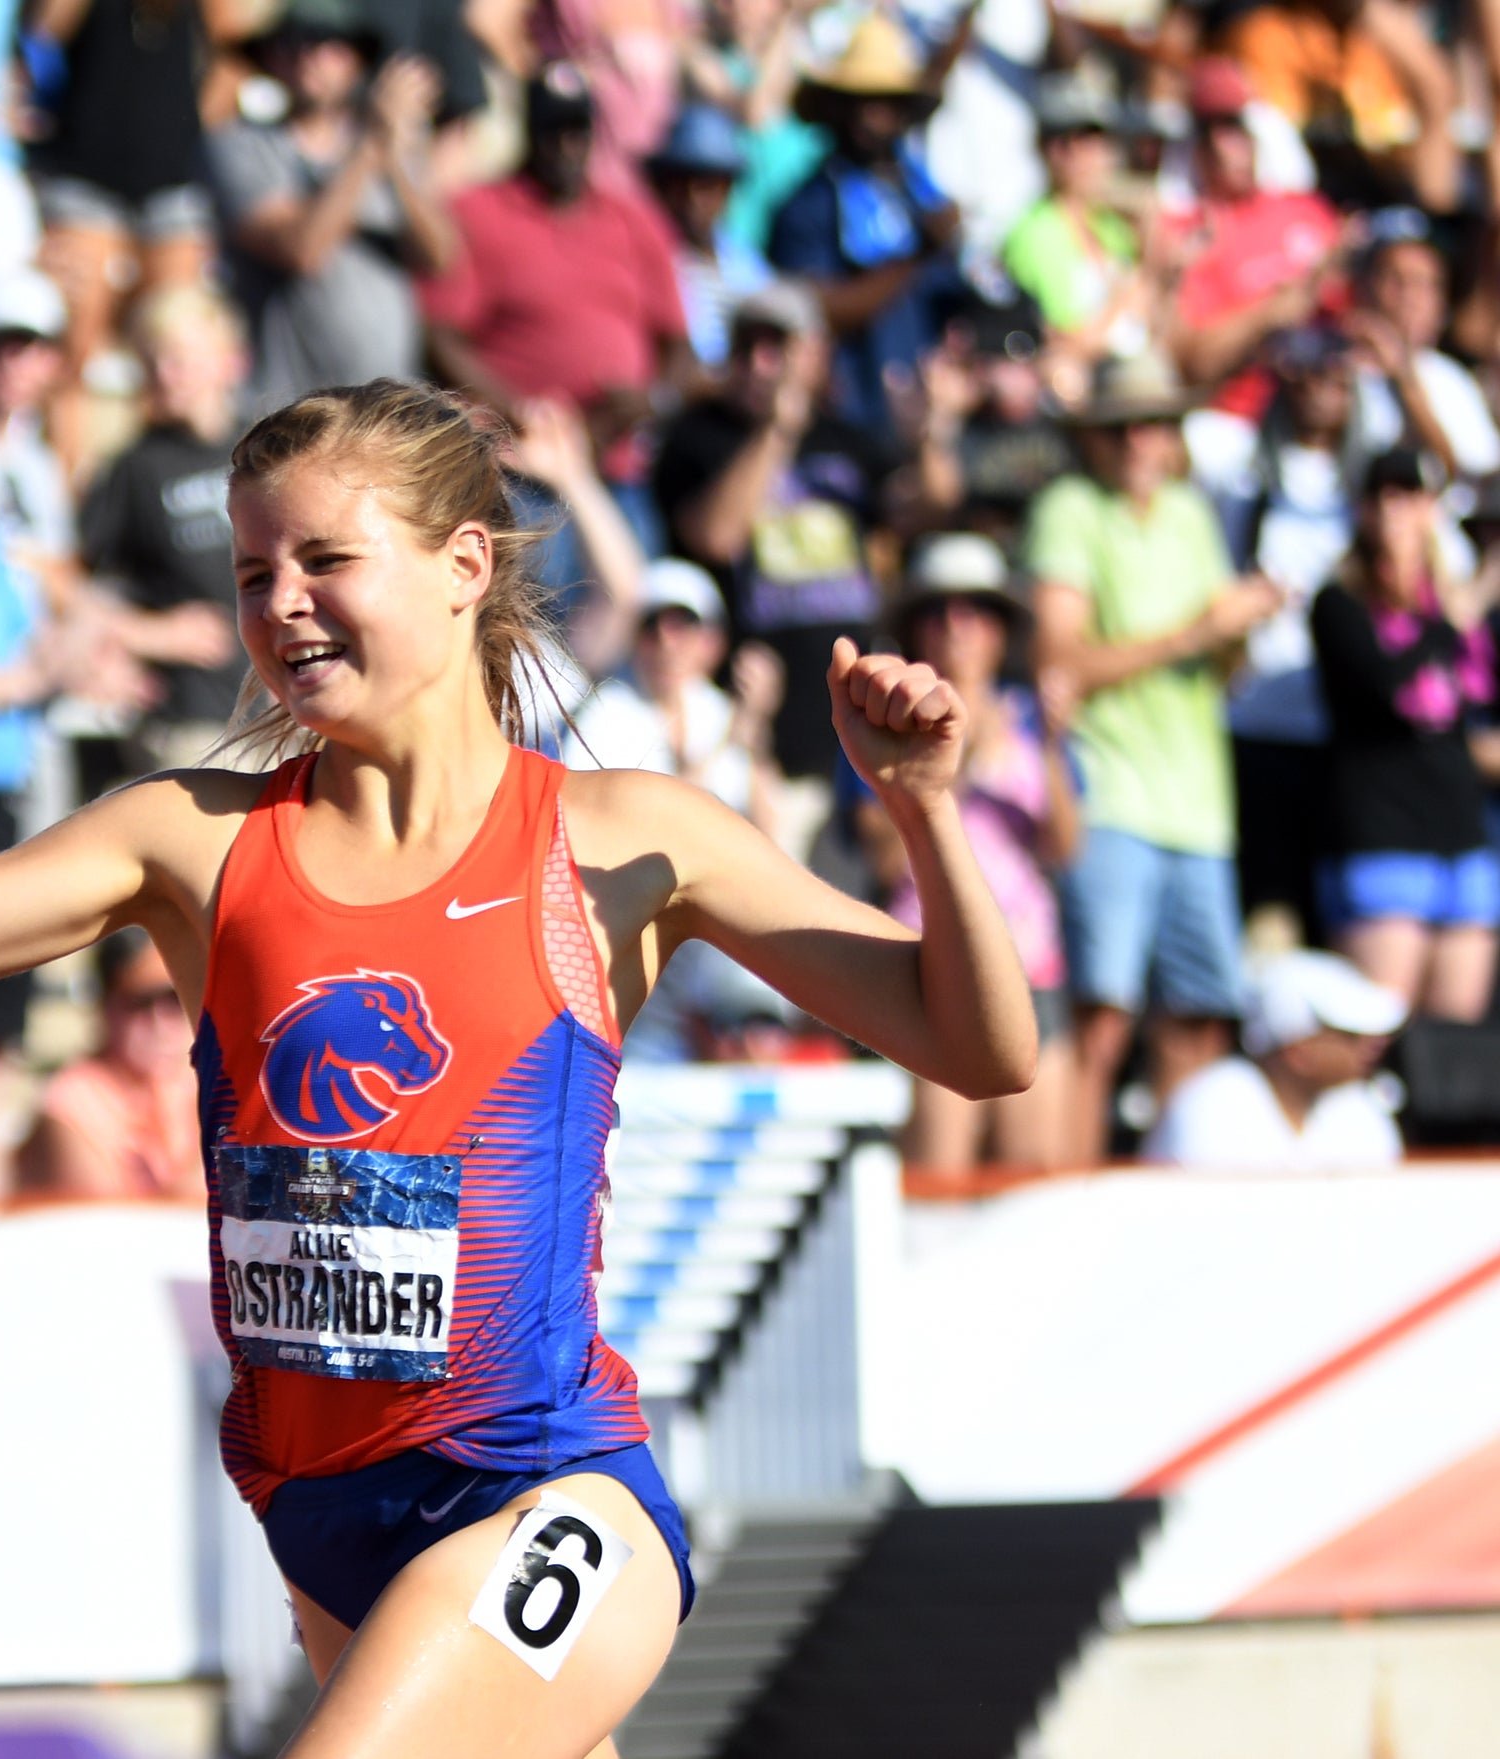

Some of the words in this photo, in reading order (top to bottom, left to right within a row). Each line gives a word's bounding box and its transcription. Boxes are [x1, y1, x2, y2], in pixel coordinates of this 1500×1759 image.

[289, 1231, 351, 1262] ALLIE
[226, 1260, 443, 1339] OSTRANDER
[504, 1515, 603, 1649] 6
